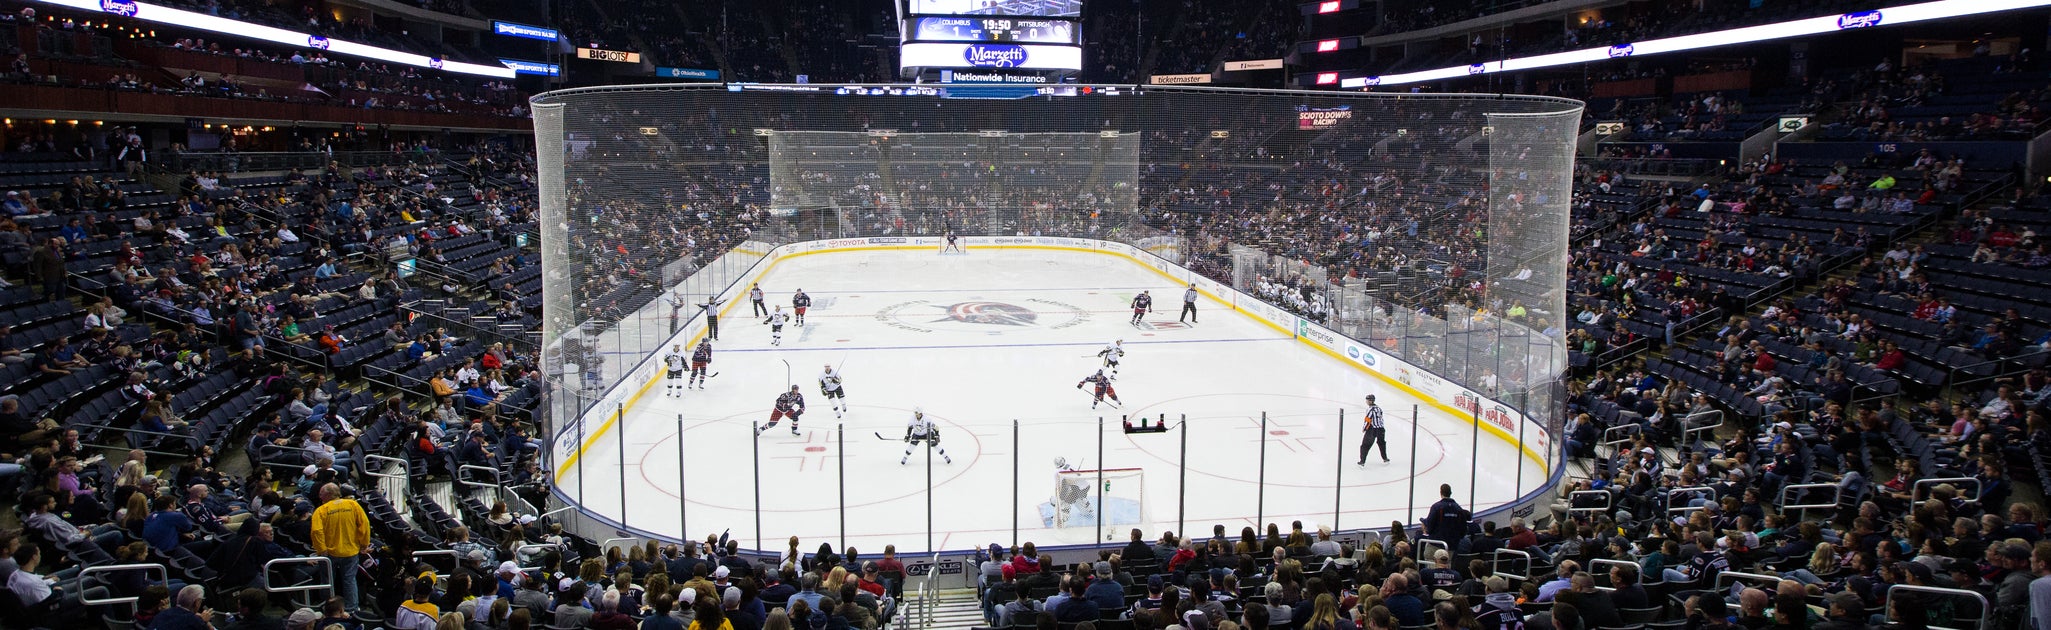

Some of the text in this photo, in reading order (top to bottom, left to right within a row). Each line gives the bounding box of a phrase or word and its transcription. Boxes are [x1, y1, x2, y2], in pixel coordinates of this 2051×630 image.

[982, 20, 1011, 30] 19:50
[952, 27, 959, 37] 1
[1029, 28, 1038, 39] 0
[969, 46, 1023, 67] Marzetti
[953, 73, 1046, 83] Nationwide Insurance
[1158, 76, 1201, 84] ticketmaster
[1299, 111, 1352, 120] SCIOTO DOWNS
[1878, 144, 1896, 152] 105
[839, 239, 866, 247] TOYOTA
